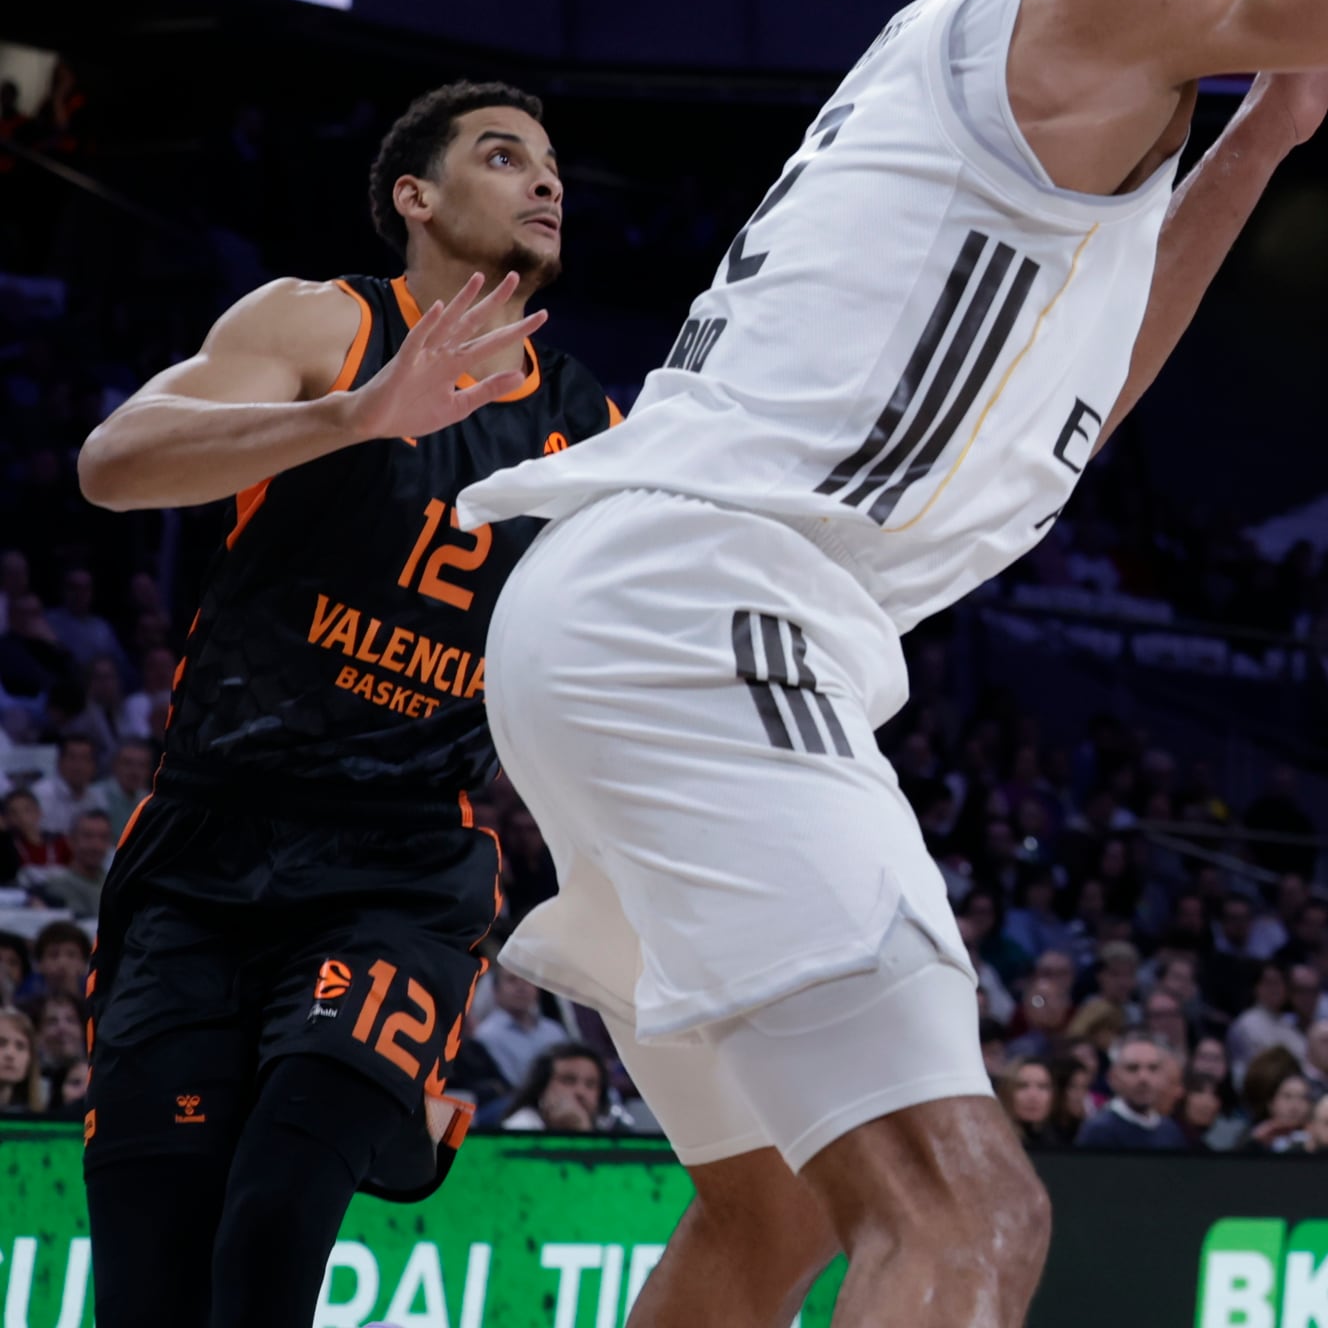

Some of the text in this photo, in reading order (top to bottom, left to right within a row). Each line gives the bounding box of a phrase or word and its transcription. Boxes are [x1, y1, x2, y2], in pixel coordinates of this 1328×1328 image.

[396, 496, 494, 613] 12
[306, 592, 486, 703] VALENCIA
[333, 663, 441, 719] BASKET
[351, 958, 437, 1080] 12
